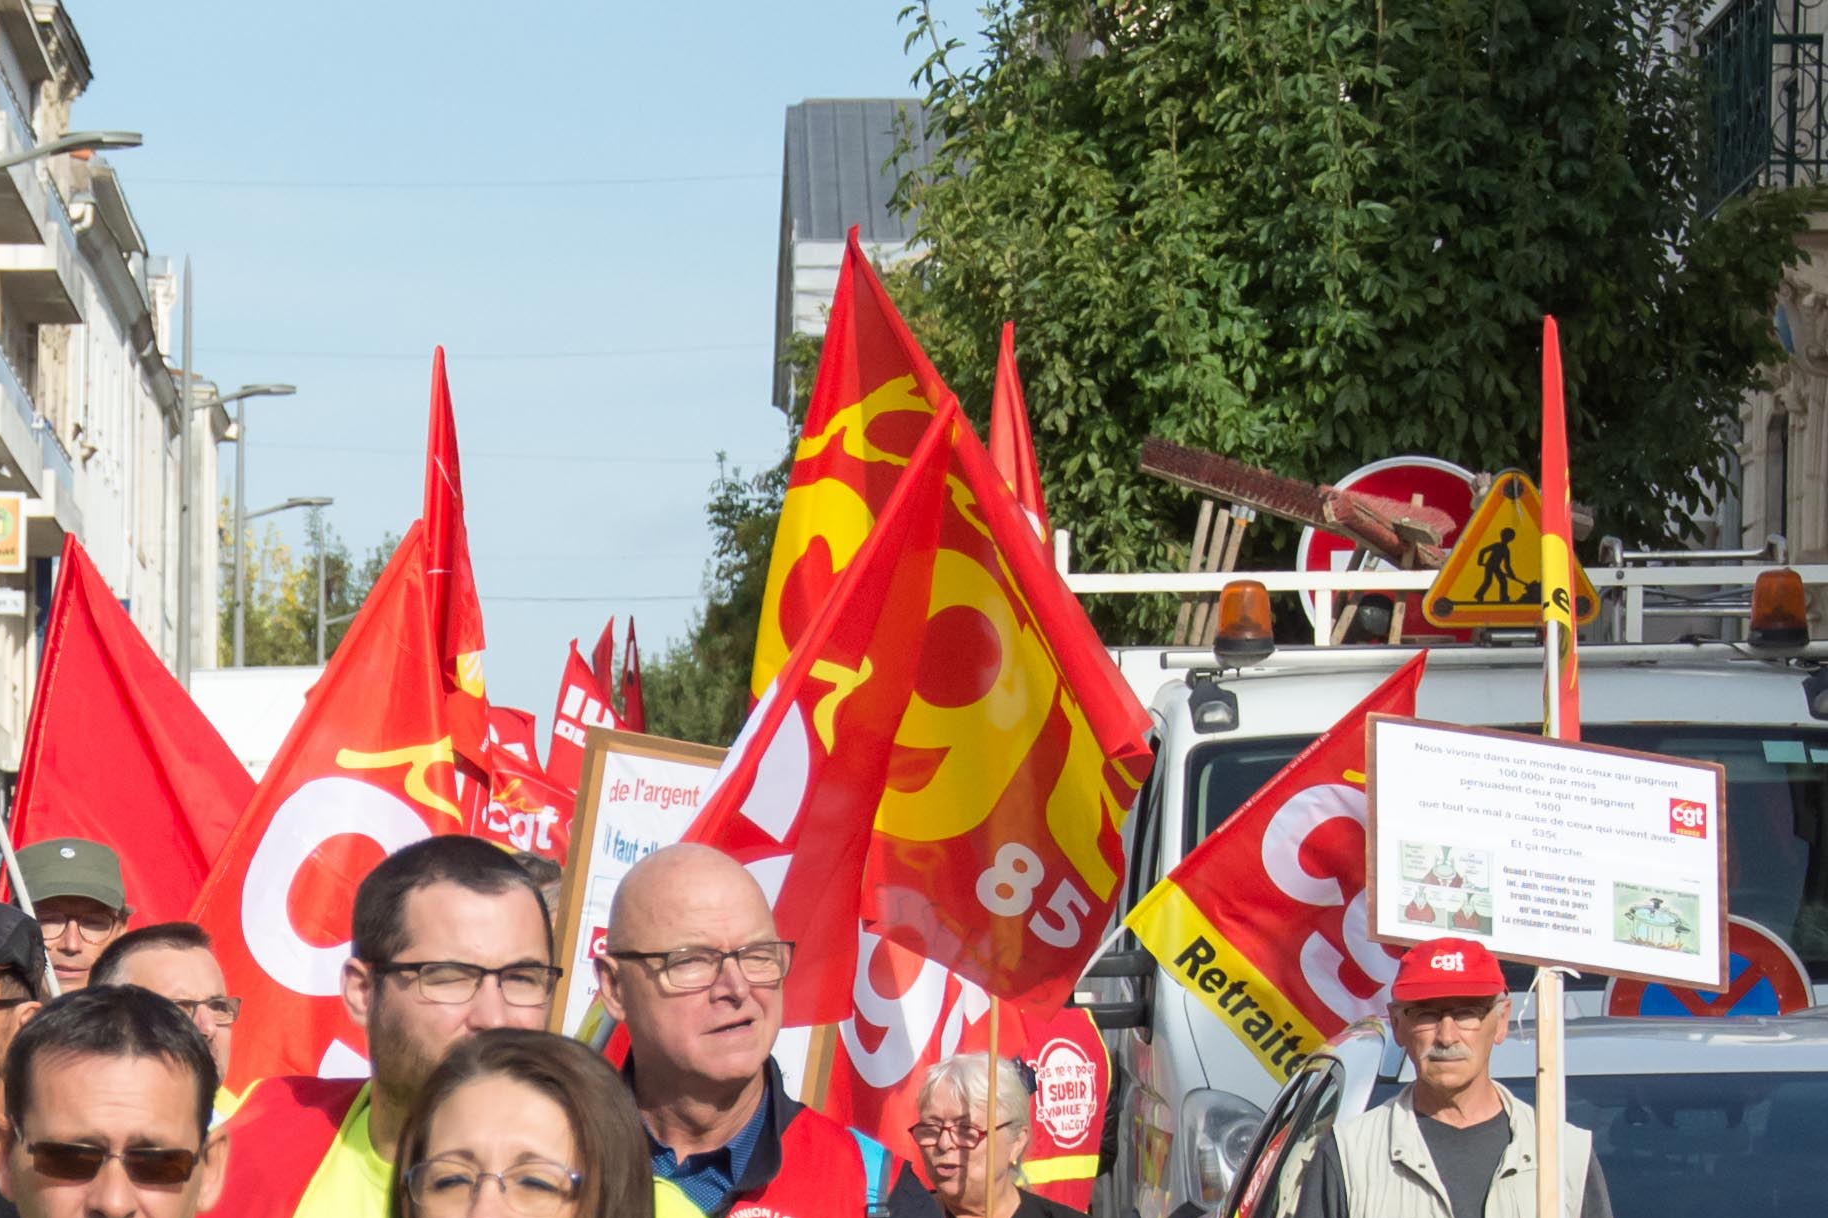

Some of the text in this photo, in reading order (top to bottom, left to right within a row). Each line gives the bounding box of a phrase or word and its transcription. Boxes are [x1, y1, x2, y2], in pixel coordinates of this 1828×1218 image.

[1414, 742, 1443, 754] Nous
[1446, 748, 1481, 759] vivons
[1483, 751, 1510, 763] dans
[1529, 759, 1567, 771] monde
[1586, 769, 1612, 778] ceux
[1615, 772, 1631, 782] qui
[1634, 775, 1679, 789] gagnent
[609, 778, 700, 809] de l'argent
[1460, 778, 1635, 810] persuadent ceux qui en gagnent
[1549, 776, 1567, 786] par
[1571, 779, 1597, 789] mois
[482, 801, 558, 851] cgt
[1419, 800, 1439, 809] que
[1442, 802, 1463, 812] tout
[1467, 806, 1479, 814] va
[1482, 808, 1502, 817] mal
[1515, 813, 1547, 824] cause
[1550, 817, 1564, 826] de
[1567, 821, 1592, 830] ceux
[1596, 824, 1612, 834] qui
[1615, 828, 1647, 839] vivent
[1651, 832, 1676, 844] avec
[1672, 805, 1704, 827] cgt
[613, 831, 639, 865] faut
[1511, 839, 1521, 848] Et
[976, 842, 1090, 949] 85
[1431, 952, 1465, 972] cgt
[1049, 1081, 1087, 1102] SUBIR
